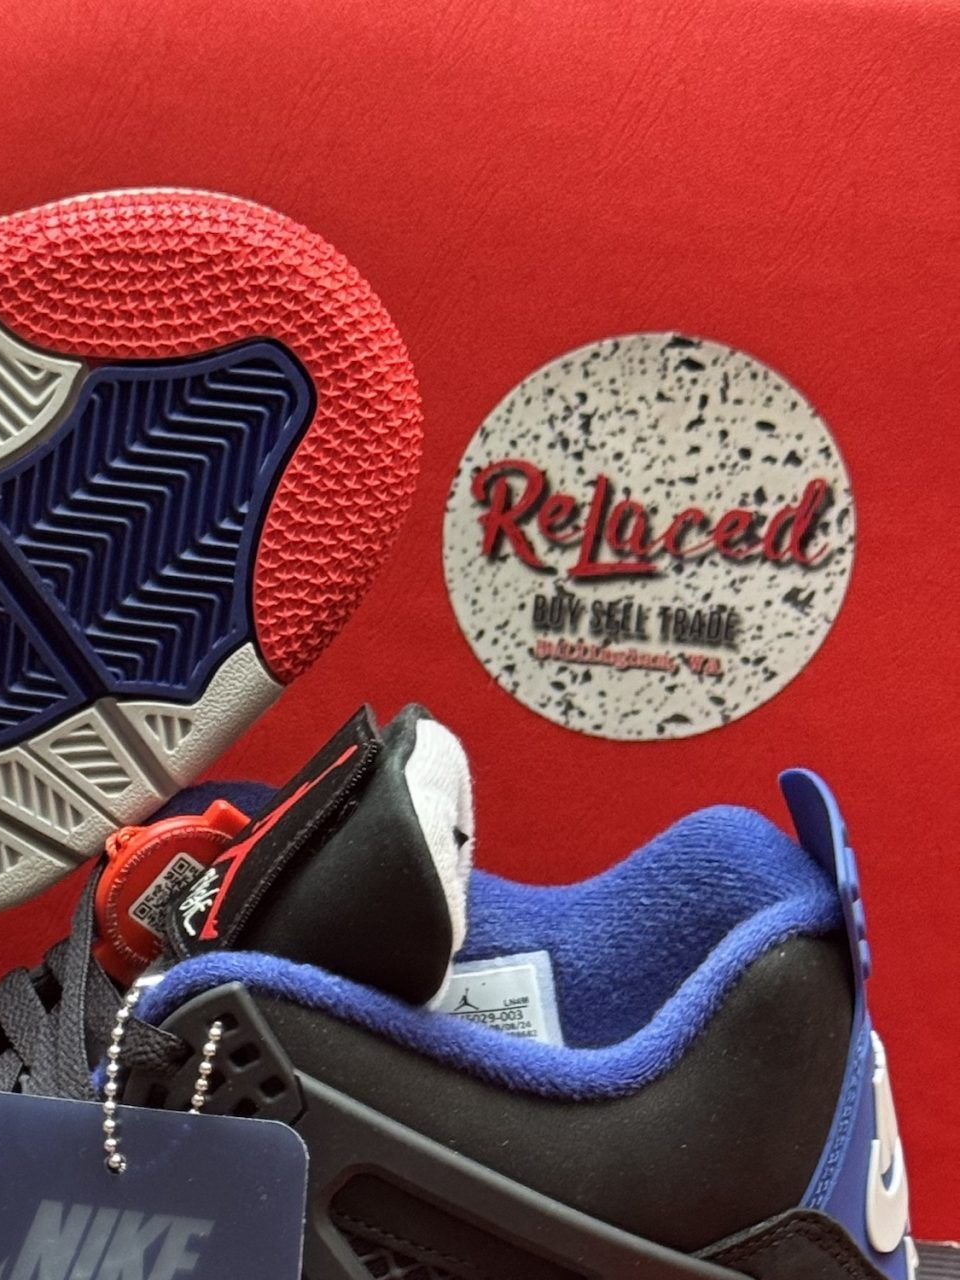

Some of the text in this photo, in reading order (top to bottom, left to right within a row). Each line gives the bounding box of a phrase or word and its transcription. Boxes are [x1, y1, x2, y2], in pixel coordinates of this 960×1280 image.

[533, 594, 741, 643] BUY SELL TRADE
